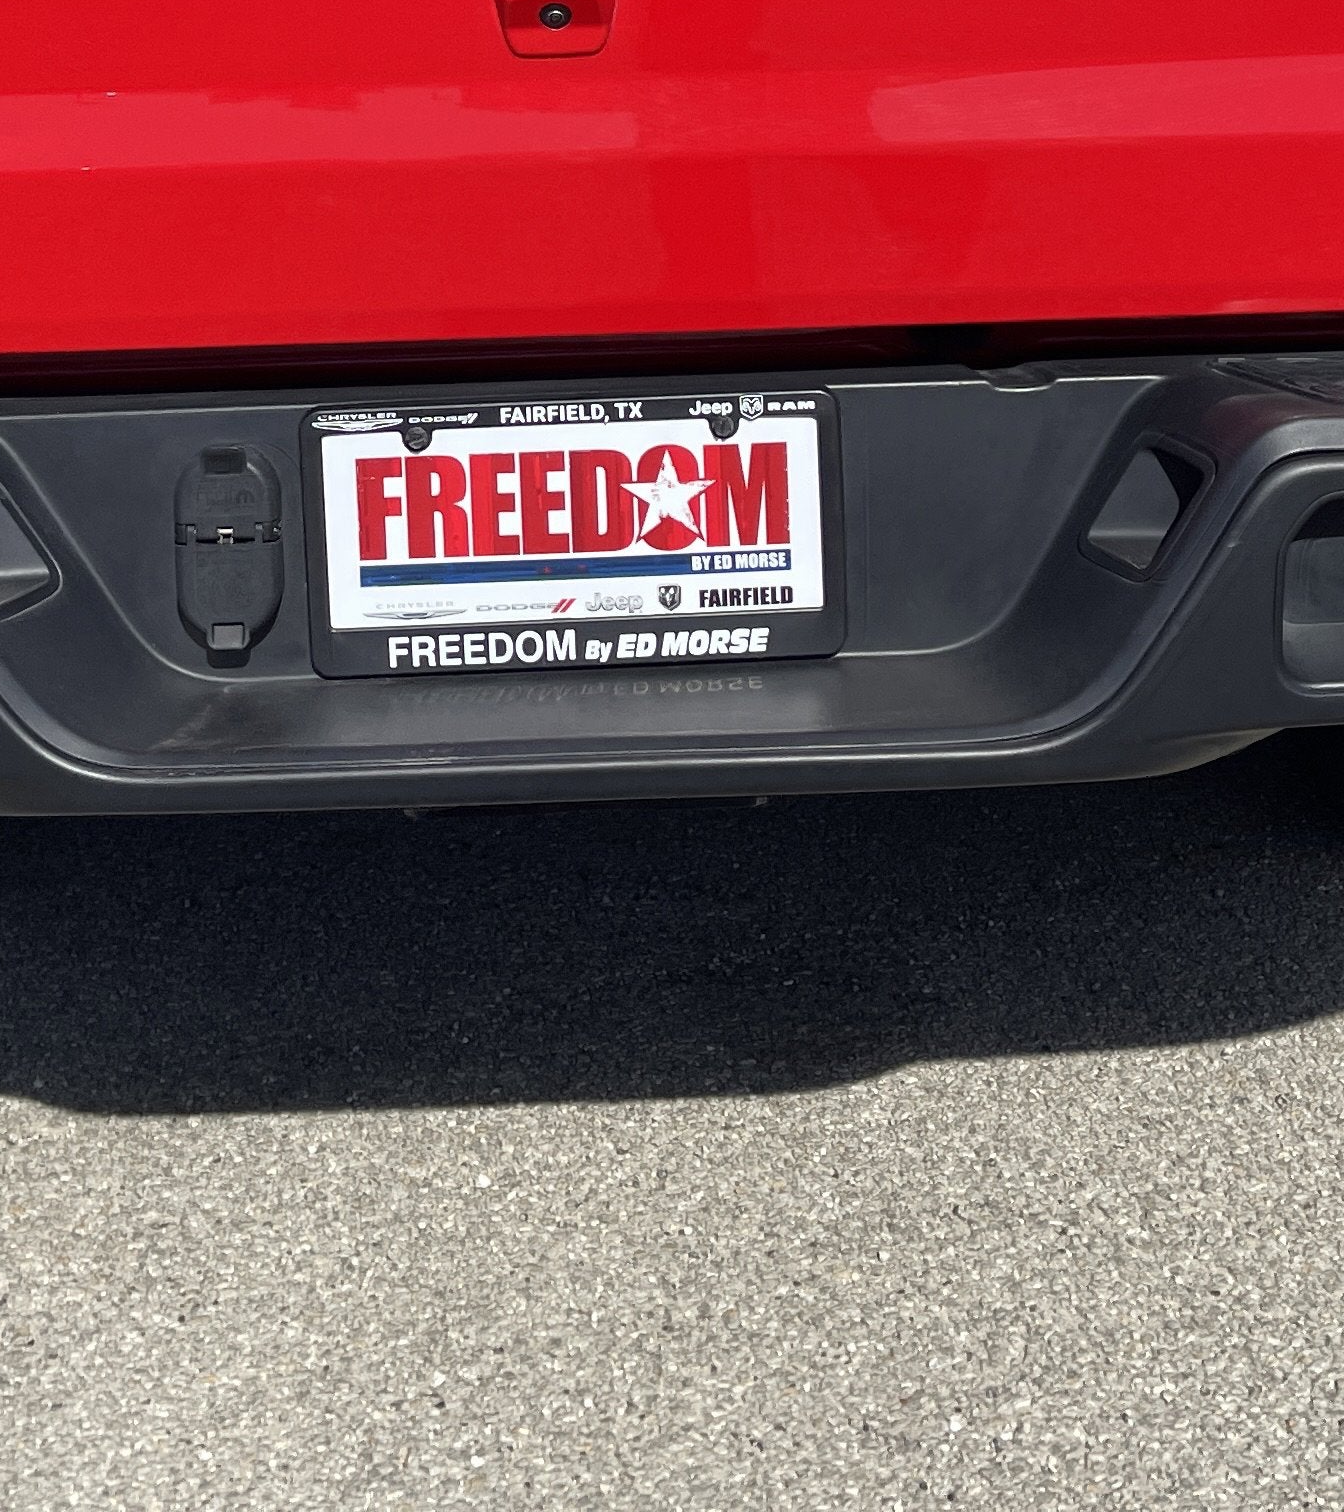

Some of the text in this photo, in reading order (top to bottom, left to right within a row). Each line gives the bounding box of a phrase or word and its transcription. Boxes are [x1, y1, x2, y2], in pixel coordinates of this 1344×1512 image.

[317, 412, 397, 422] CHRYSLER
[500, 403, 610, 424] FAIRFIELD,
[614, 402, 643, 419] TX
[688, 400, 733, 416] Jeep
[767, 400, 816, 411] RAM
[356, 442, 790, 561] FREEDOM
[691, 552, 786, 571] BY ED MORSE
[375, 600, 454, 610] CHRYSLER
[585, 592, 644, 613] Jeep
[699, 586, 793, 608] FAIRFIELD
[388, 627, 770, 668] FREEDOM By ED MORSE
